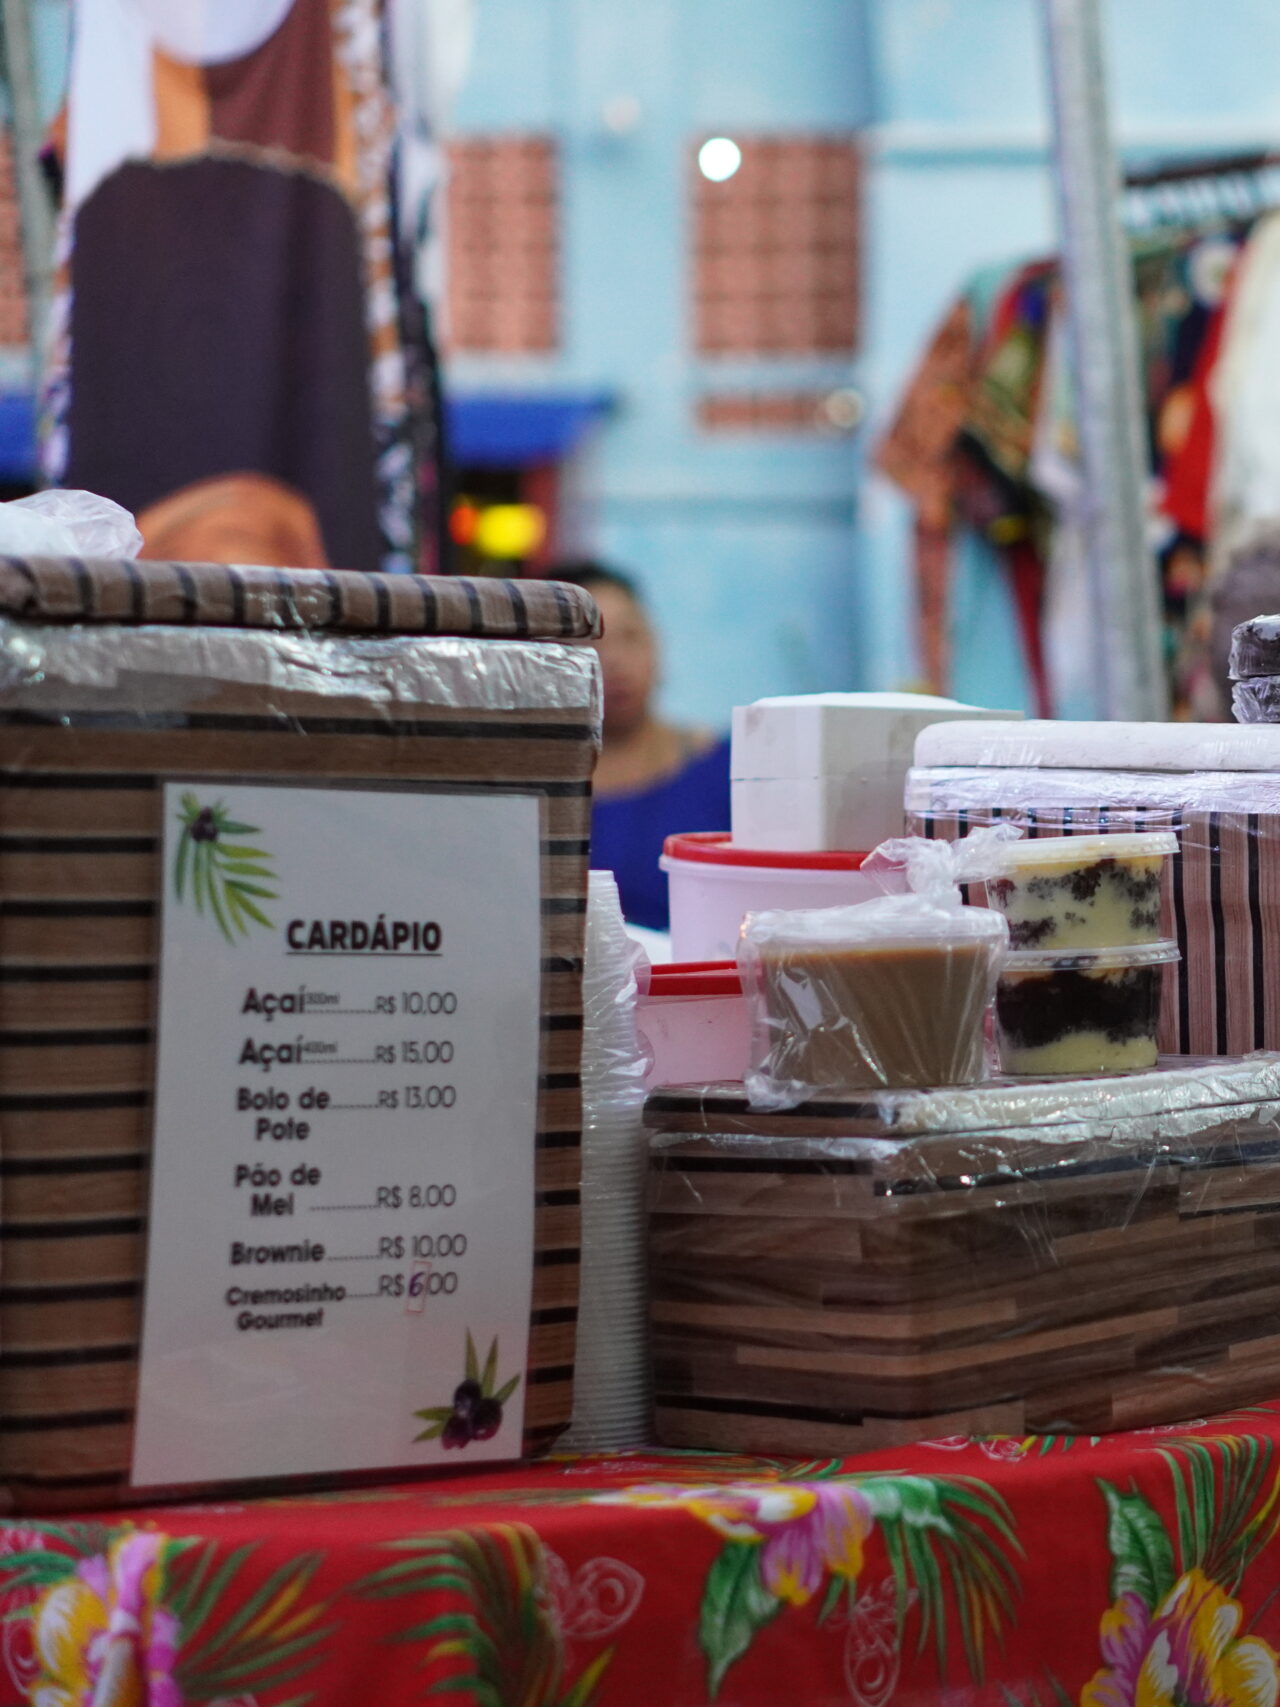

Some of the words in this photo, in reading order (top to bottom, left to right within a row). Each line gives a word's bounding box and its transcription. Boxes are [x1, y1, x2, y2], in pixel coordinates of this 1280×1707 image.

[287, 914, 442, 951] CARDÁPIO
[242, 985, 304, 1022] Açaí
[375, 995, 397, 1015] R$
[238, 1034, 303, 1073] Açaí
[375, 1044, 396, 1064] R$
[237, 1086, 290, 1111] Bolo
[299, 1086, 330, 1110] de
[378, 1090, 398, 1109] R$
[257, 1117, 310, 1141] Pote
[234, 1163, 282, 1188] Pão
[290, 1163, 322, 1187] de
[250, 1193, 294, 1217] Mel
[377, 1186, 402, 1209] R$
[230, 1239, 325, 1266] Brownie
[379, 1235, 404, 1259] R$
[225, 1283, 346, 1306] Cremosinho
[379, 1274, 405, 1298] R$
[236, 1308, 325, 1332] Gourmet
